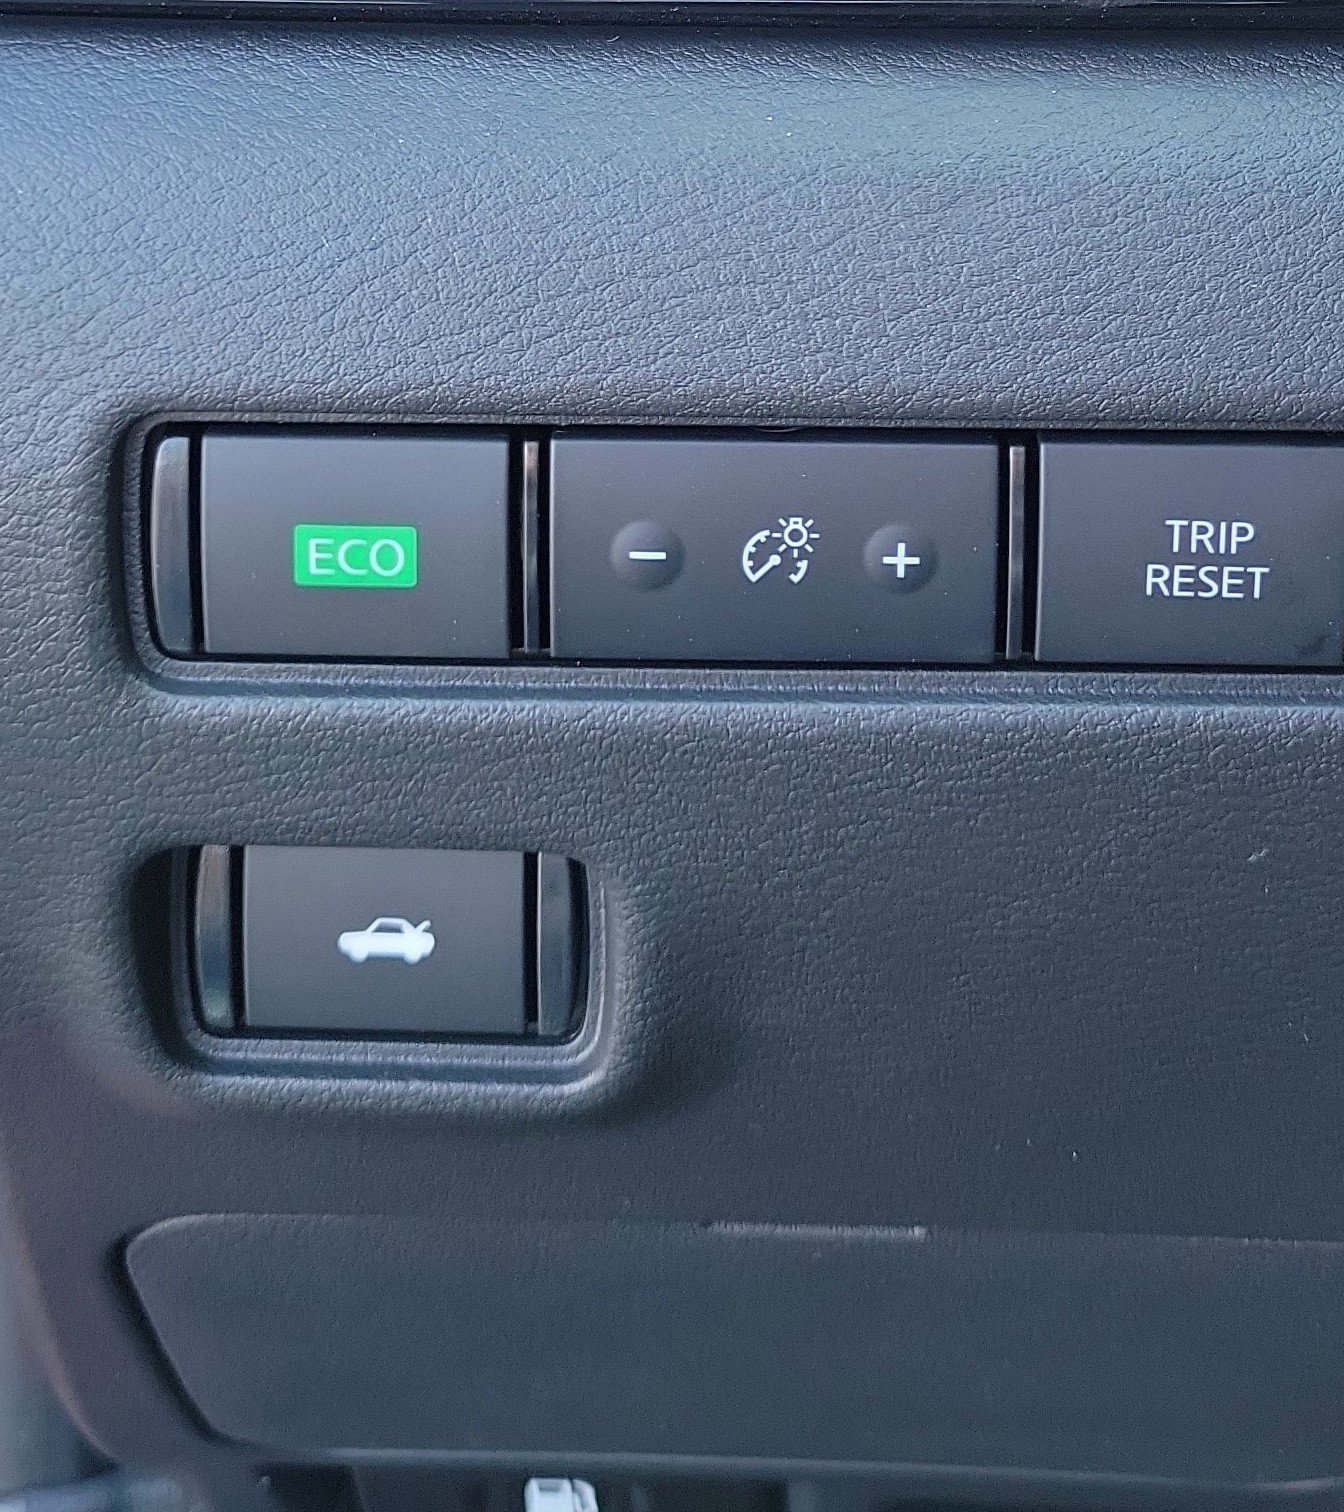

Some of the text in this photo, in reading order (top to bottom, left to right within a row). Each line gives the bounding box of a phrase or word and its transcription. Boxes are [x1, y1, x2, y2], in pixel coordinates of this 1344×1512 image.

[1165, 519, 1255, 555] TRIP
[308, 537, 406, 578] ECO
[1145, 563, 1271, 600] RESET
